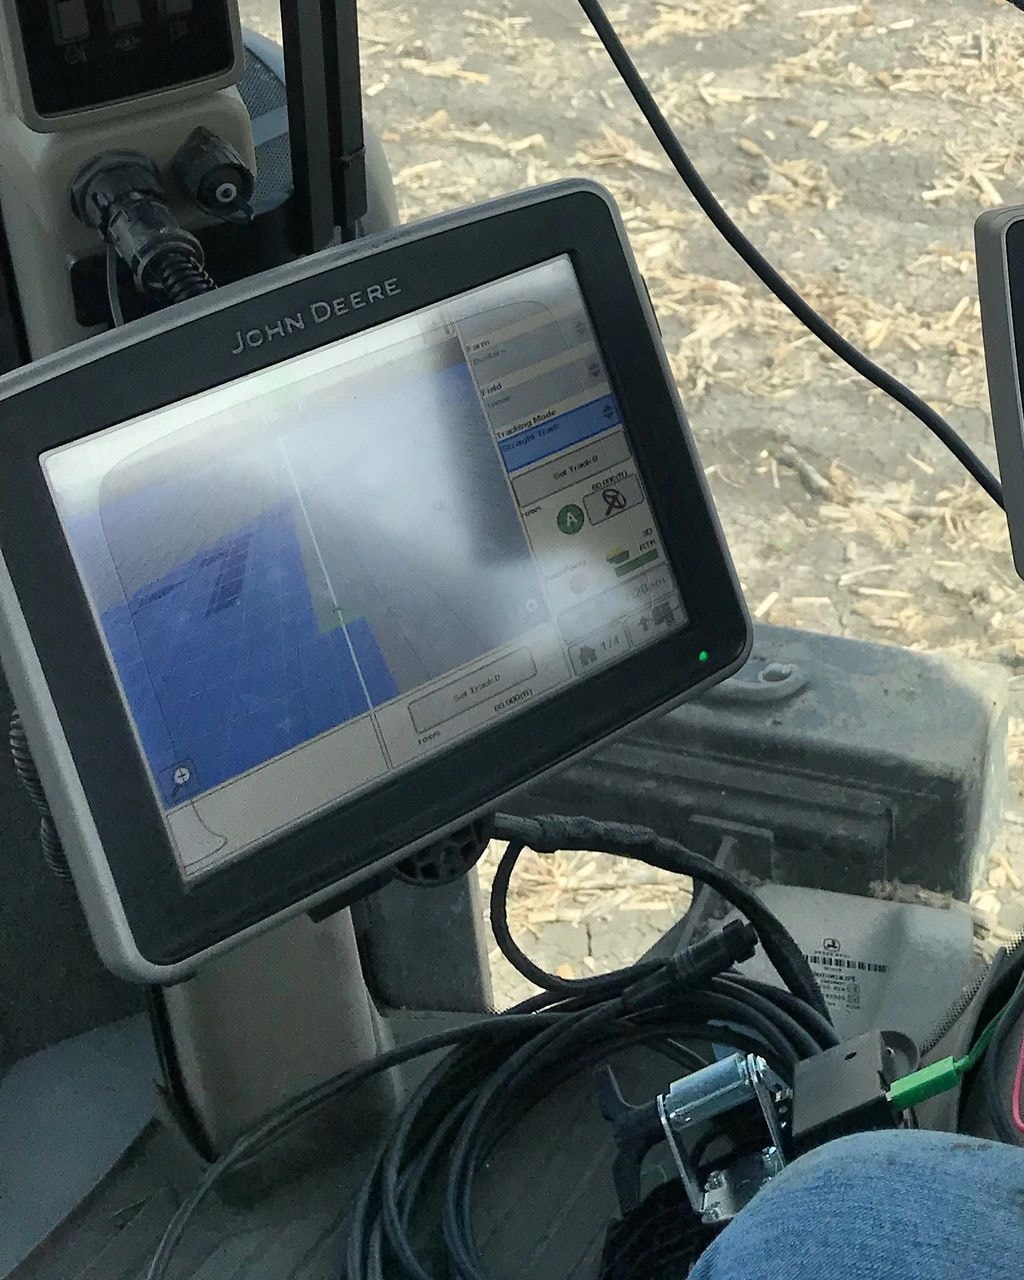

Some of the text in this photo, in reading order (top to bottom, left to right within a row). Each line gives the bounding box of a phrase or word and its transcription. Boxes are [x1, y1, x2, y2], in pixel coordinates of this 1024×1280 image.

[232, 277, 402, 355] JOHN DEERE
[481, 382, 503, 397] Field
[496, 409, 557, 438] Tracking Mode
[566, 512, 578, 528] A
[601, 634, 620, 652] 1/4
